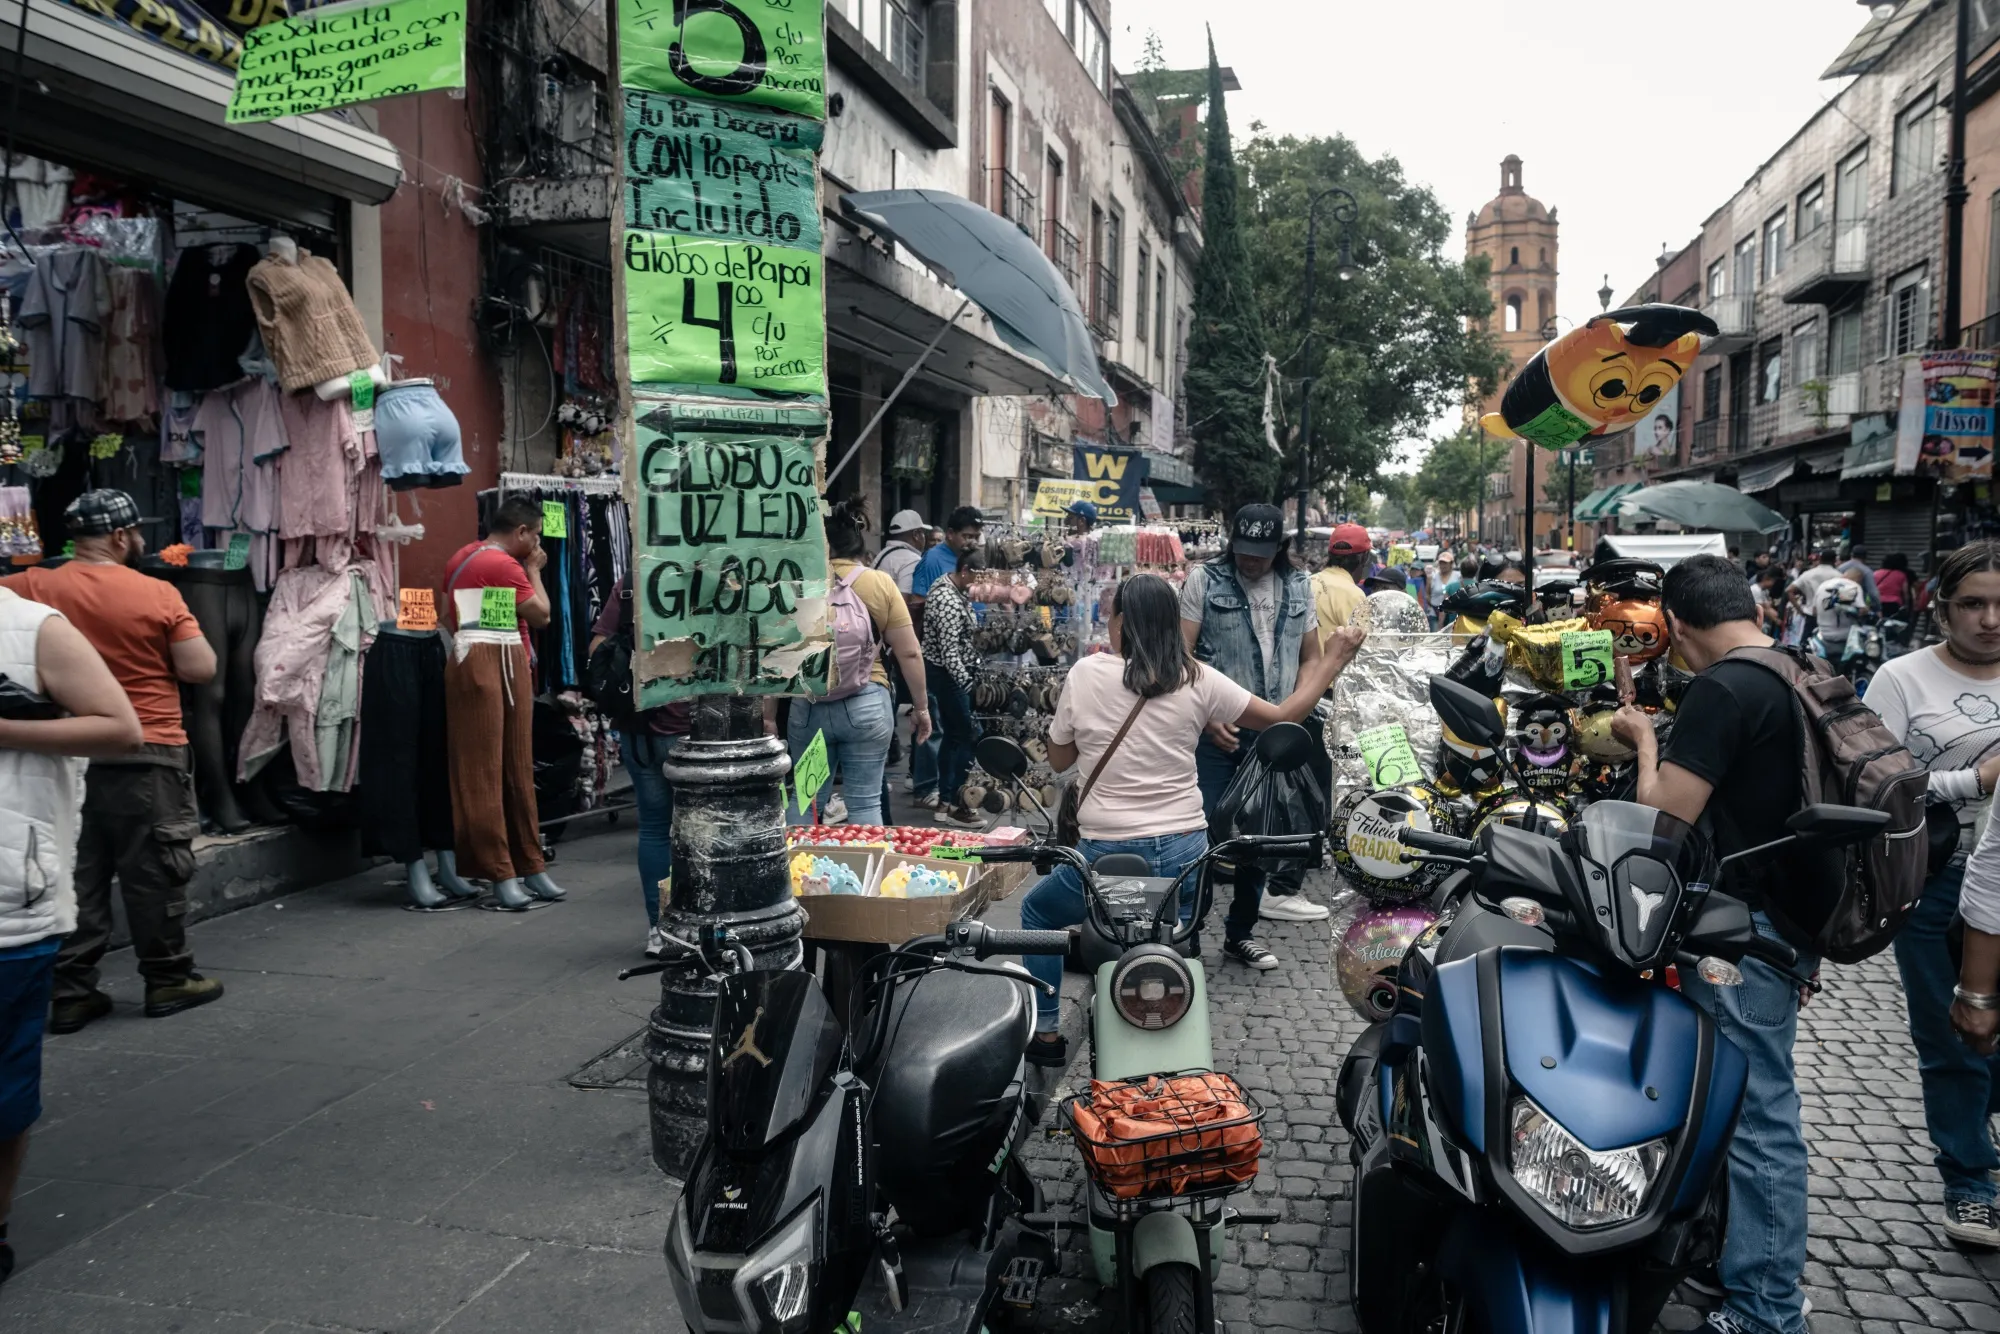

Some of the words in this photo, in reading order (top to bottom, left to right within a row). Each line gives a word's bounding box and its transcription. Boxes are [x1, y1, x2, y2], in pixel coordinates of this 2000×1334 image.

[278, 7, 391, 43] Solicita
[407, 10, 461, 36] con
[237, 62, 334, 91] muchas
[337, 44, 411, 82] ganas
[413, 32, 443, 51] de
[627, 128, 693, 180] CON
[625, 177, 802, 245] Incluido
[625, 233, 709, 276] Globo
[681, 277, 738, 384] 4
[720, 406, 765, 422] PLAZA
[640, 438, 783, 493] GLOBO
[646, 491, 728, 547] LUZ
[735, 491, 808, 541] LED
[646, 554, 805, 622] GLOBO
[1570, 646, 1607, 688] 5
[1376, 745, 1404, 786] 6
[854, 1096, 864, 1186] www.honeywhale.com.mx
[728, 1202, 749, 1210] WHALE
